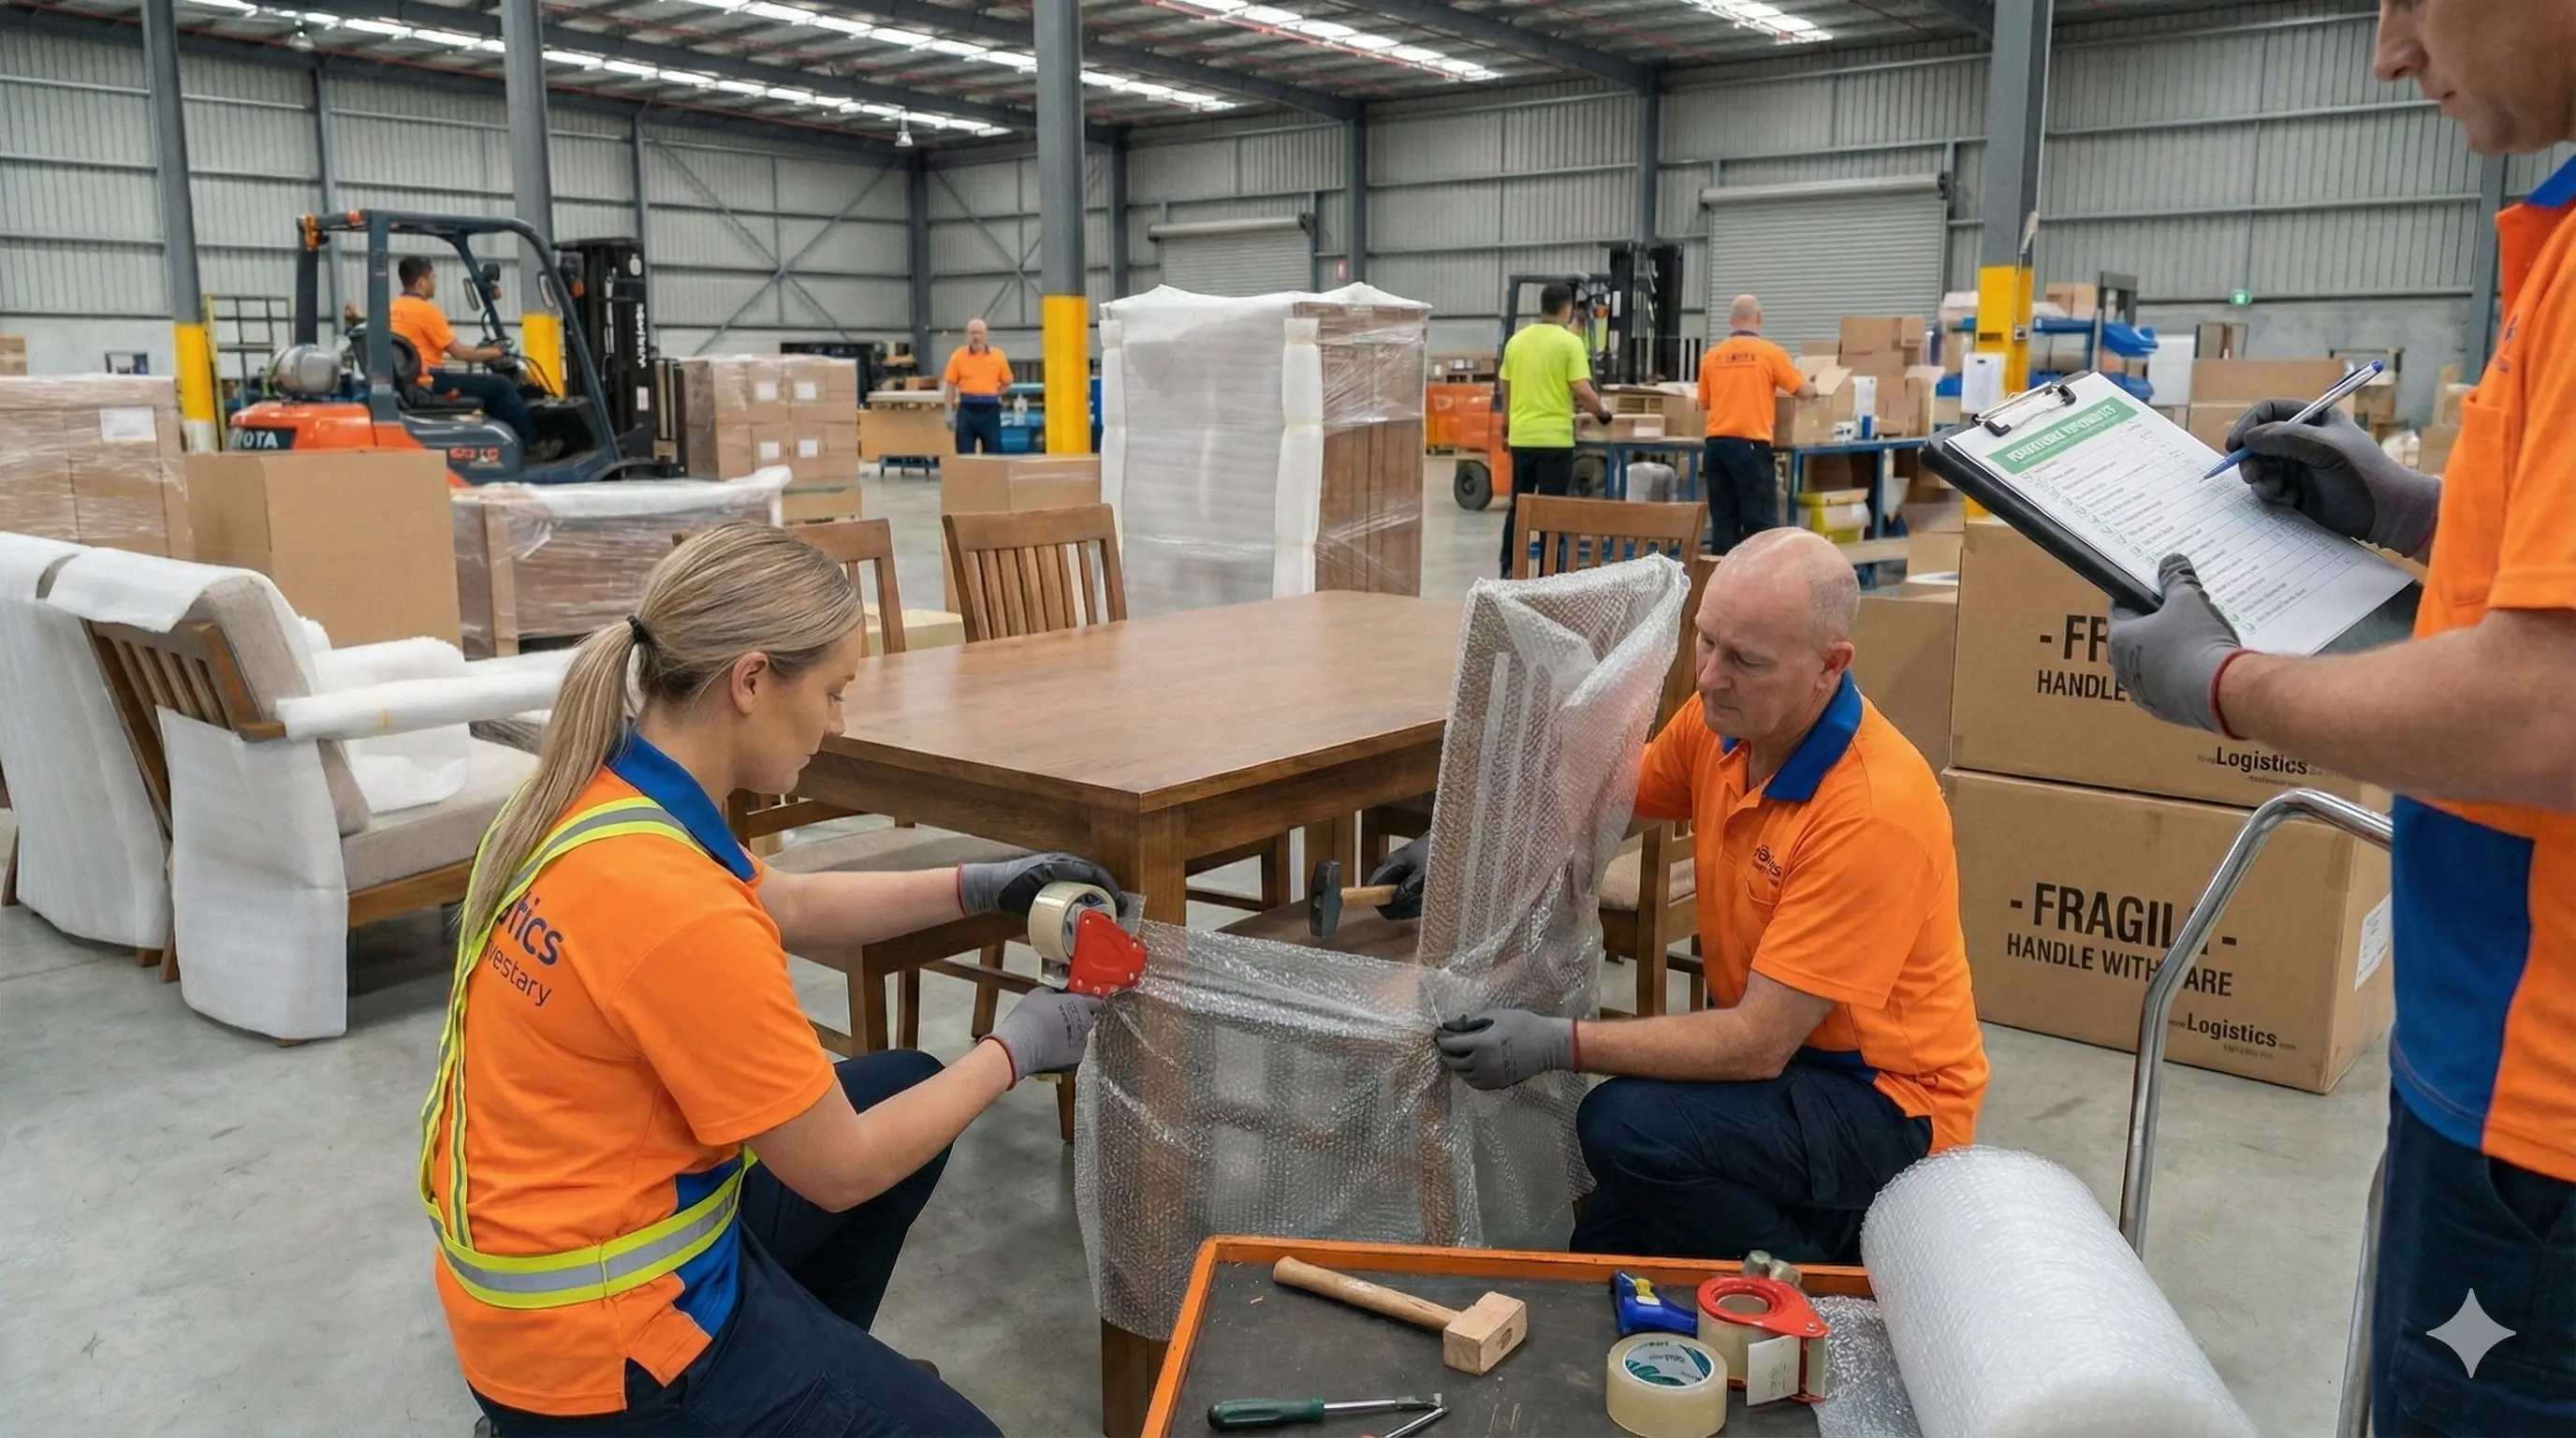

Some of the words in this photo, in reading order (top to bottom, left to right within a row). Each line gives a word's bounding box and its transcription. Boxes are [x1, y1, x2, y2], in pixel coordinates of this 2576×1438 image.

[2216, 745, 2308, 776] Logistics
[2033, 882, 2208, 955] FRAGIL
[2006, 932, 2095, 971] HANDLE
[2182, 965, 2233, 997] ARE
[2187, 1011, 2278, 1048] Logistics
